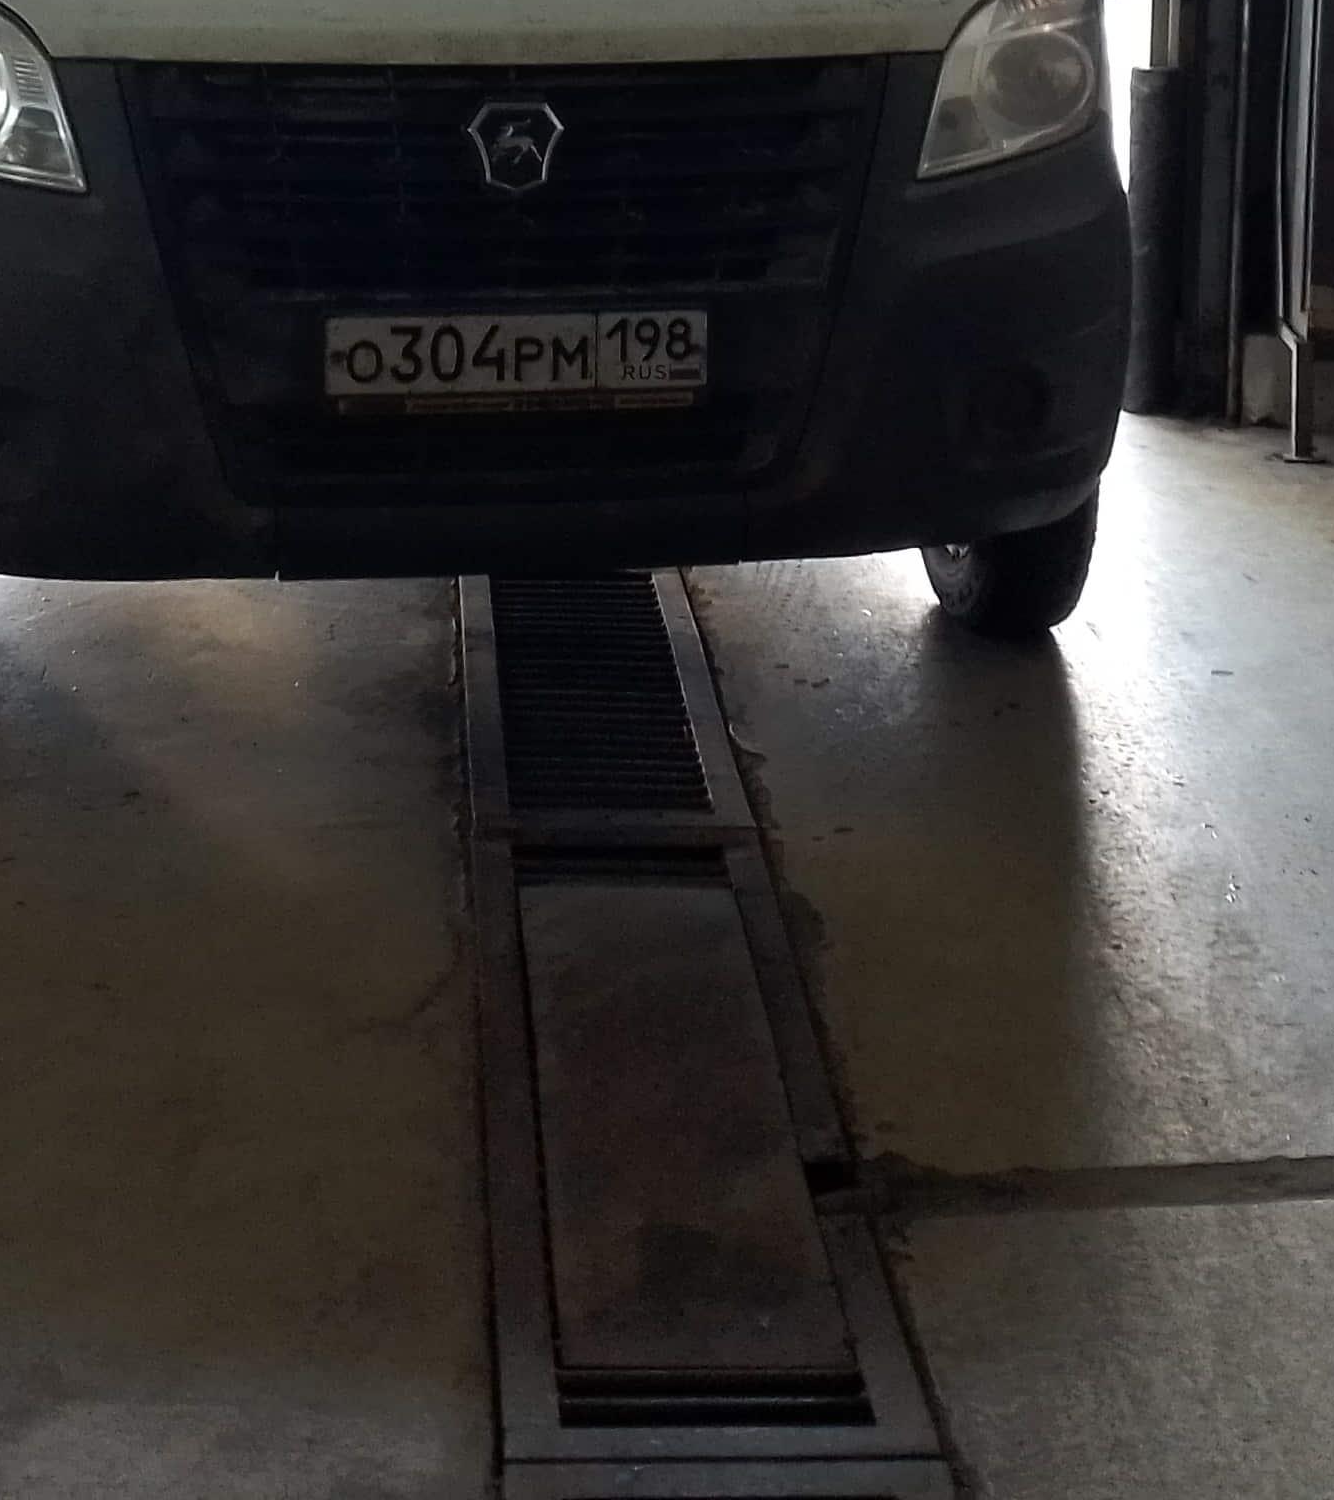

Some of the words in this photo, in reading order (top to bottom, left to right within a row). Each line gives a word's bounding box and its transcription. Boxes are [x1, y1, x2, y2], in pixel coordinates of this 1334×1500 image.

[347, 324, 589, 384] О304РМ
[605, 318, 692, 363] 198
[620, 364, 667, 381] RUS
